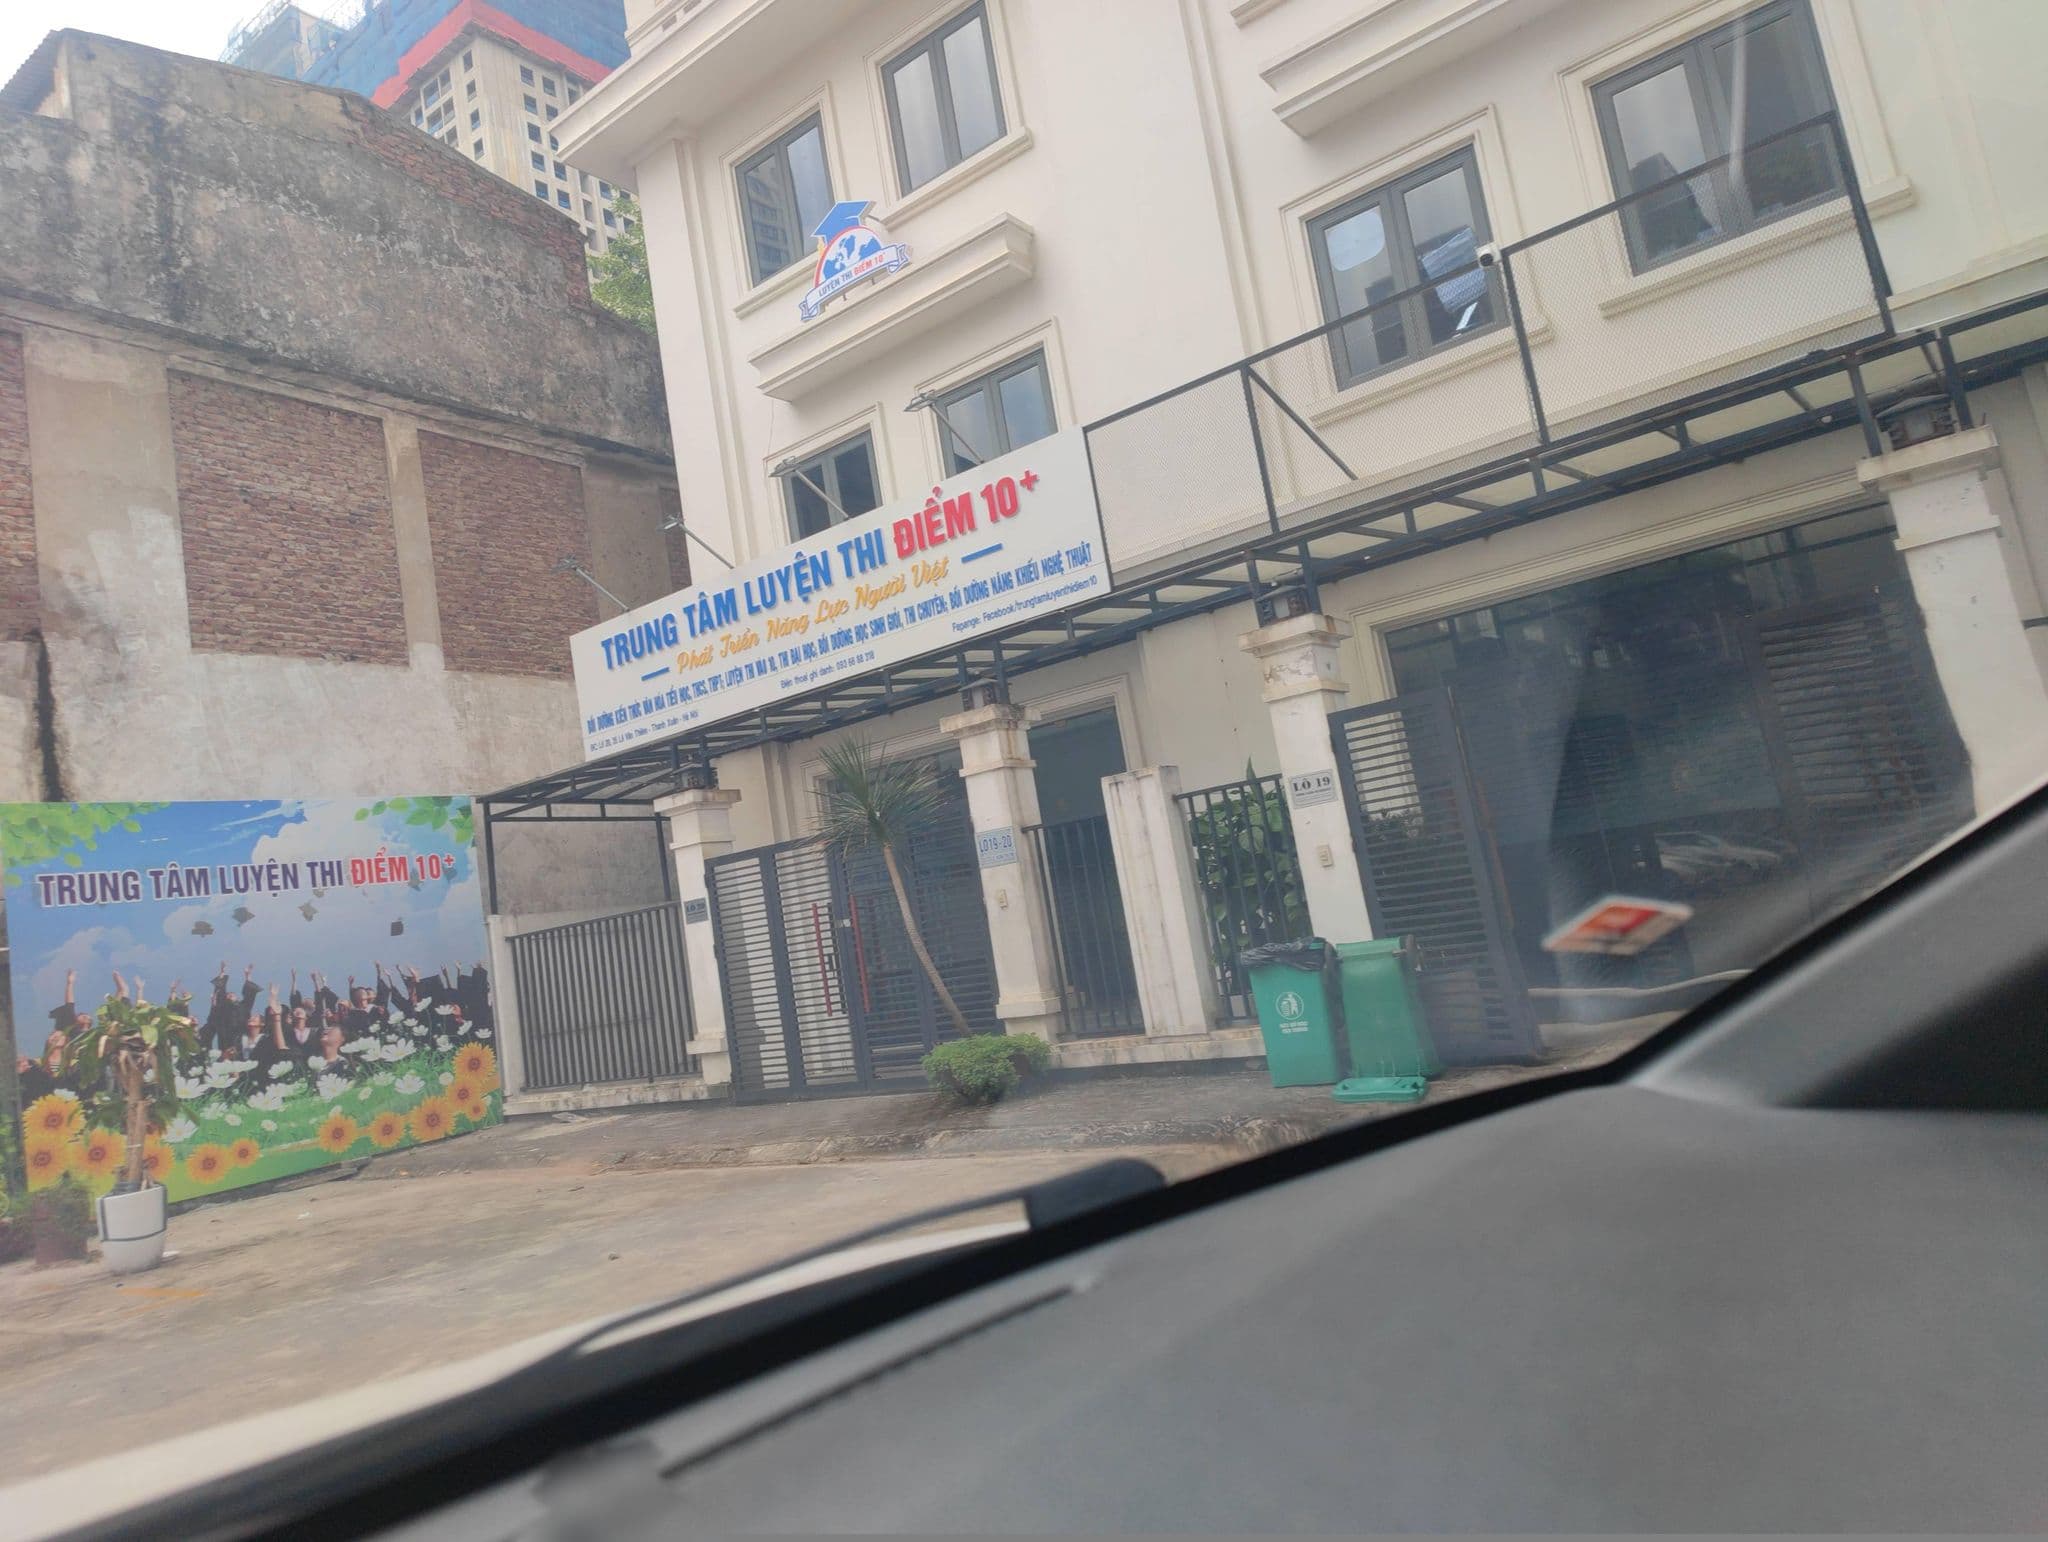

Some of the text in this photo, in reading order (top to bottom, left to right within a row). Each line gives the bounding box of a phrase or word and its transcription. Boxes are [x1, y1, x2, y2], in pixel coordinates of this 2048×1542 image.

[841, 271, 853, 283] THI
[600, 613, 678, 669] TRUNG
[682, 587, 738, 637] TÂM
[743, 550, 832, 615] LUYỆN
[836, 528, 886, 578] THI
[892, 486, 976, 559] ĐIỂM
[676, 556, 949, 673] Phát Triển Năng Lực Người Việt
[744, 662, 754, 679] THI
[777, 650, 789, 667] THI
[854, 622, 868, 643] HỌC
[869, 616, 885, 636] SINH
[903, 605, 916, 624] THI
[963, 579, 989, 604] DƯỠNG
[1014, 558, 1039, 586] KHIẾU
[1040, 550, 1064, 577] NGHỆ
[1065, 540, 1091, 568] THUẬT
[1293, 776, 1330, 792] LÔ 19
[37, 870, 142, 907] TRUNG
[149, 861, 211, 900] TÂM
[219, 857, 300, 898] LUYỆN
[306, 859, 344, 889] THI
[350, 847, 408, 887] ĐIỂM
